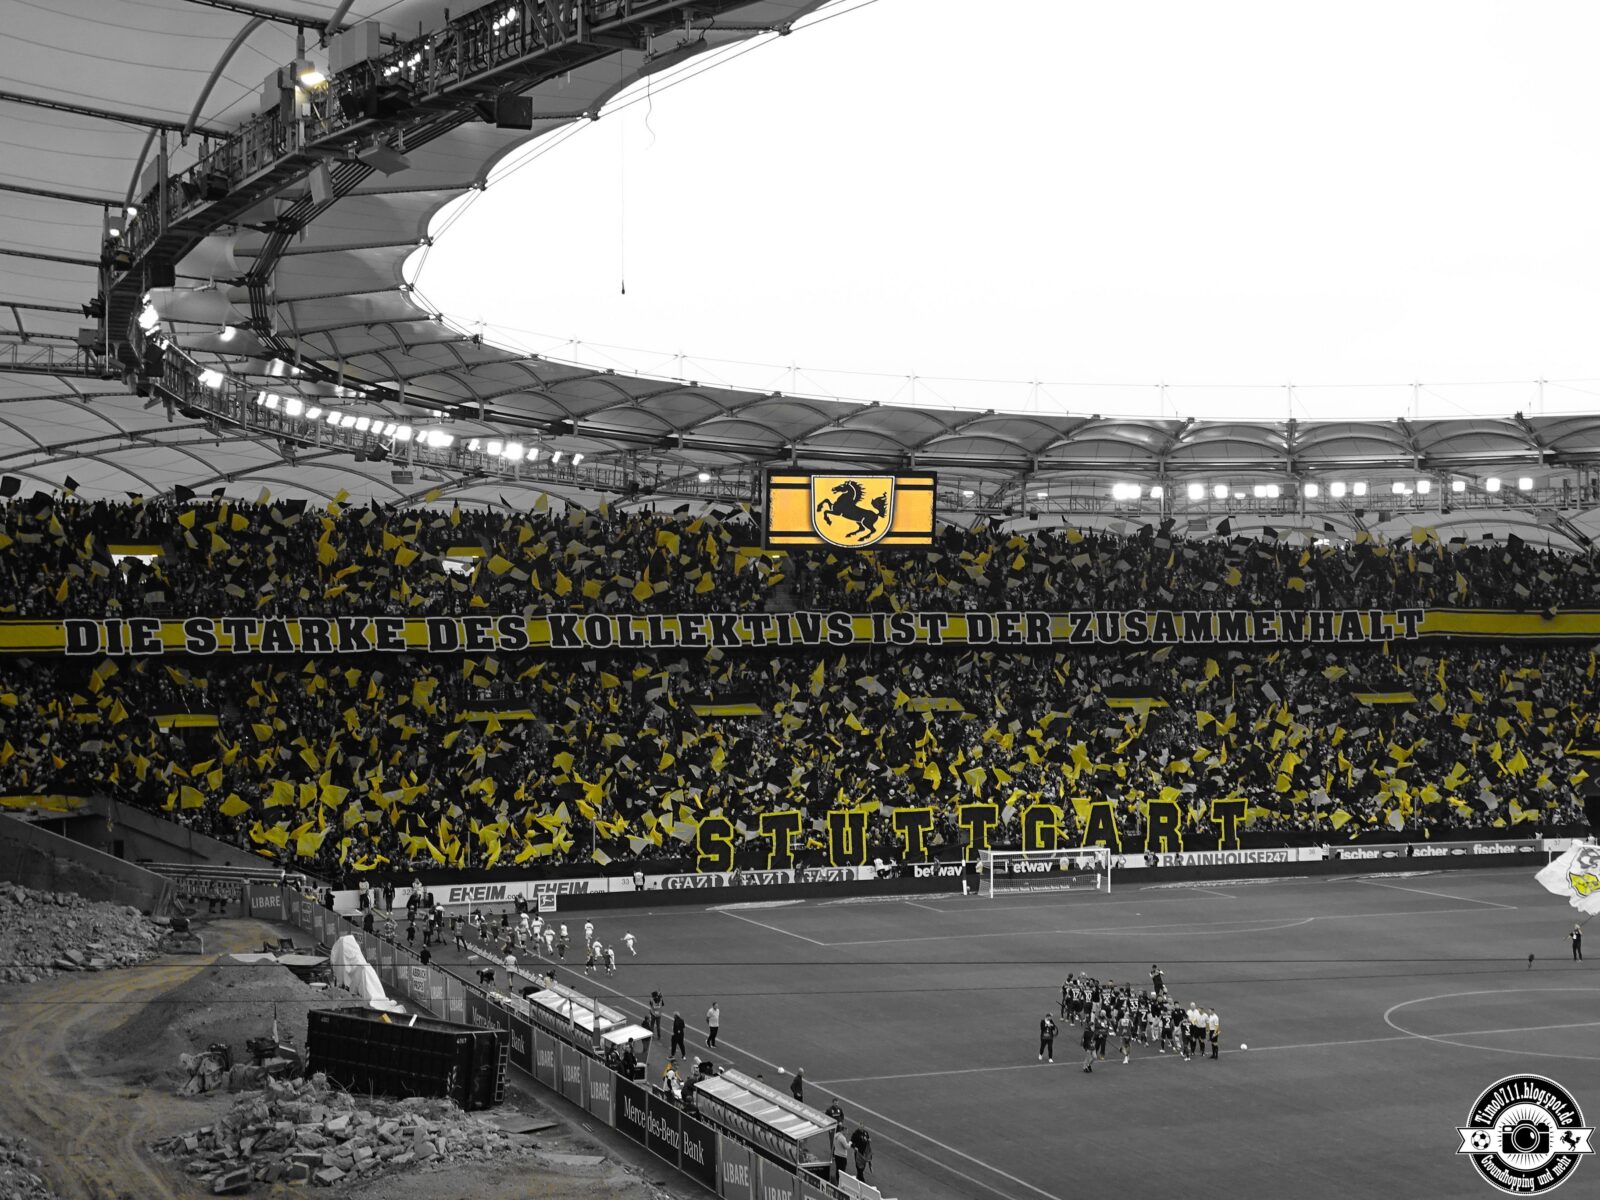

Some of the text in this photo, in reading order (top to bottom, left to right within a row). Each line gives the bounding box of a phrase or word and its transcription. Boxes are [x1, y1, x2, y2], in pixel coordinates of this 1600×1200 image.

[64, 608, 1426, 655] DIE STÄRKE DES KOLLEKTIVS IST DER ZUSAMMENHALT
[695, 797, 1249, 876] STUTTGART
[1473, 843, 1517, 856] fischer
[252, 896, 282, 909] LIBARE
[683, 1131, 704, 1166] Bank
[723, 1162, 750, 1187] LIBARE
